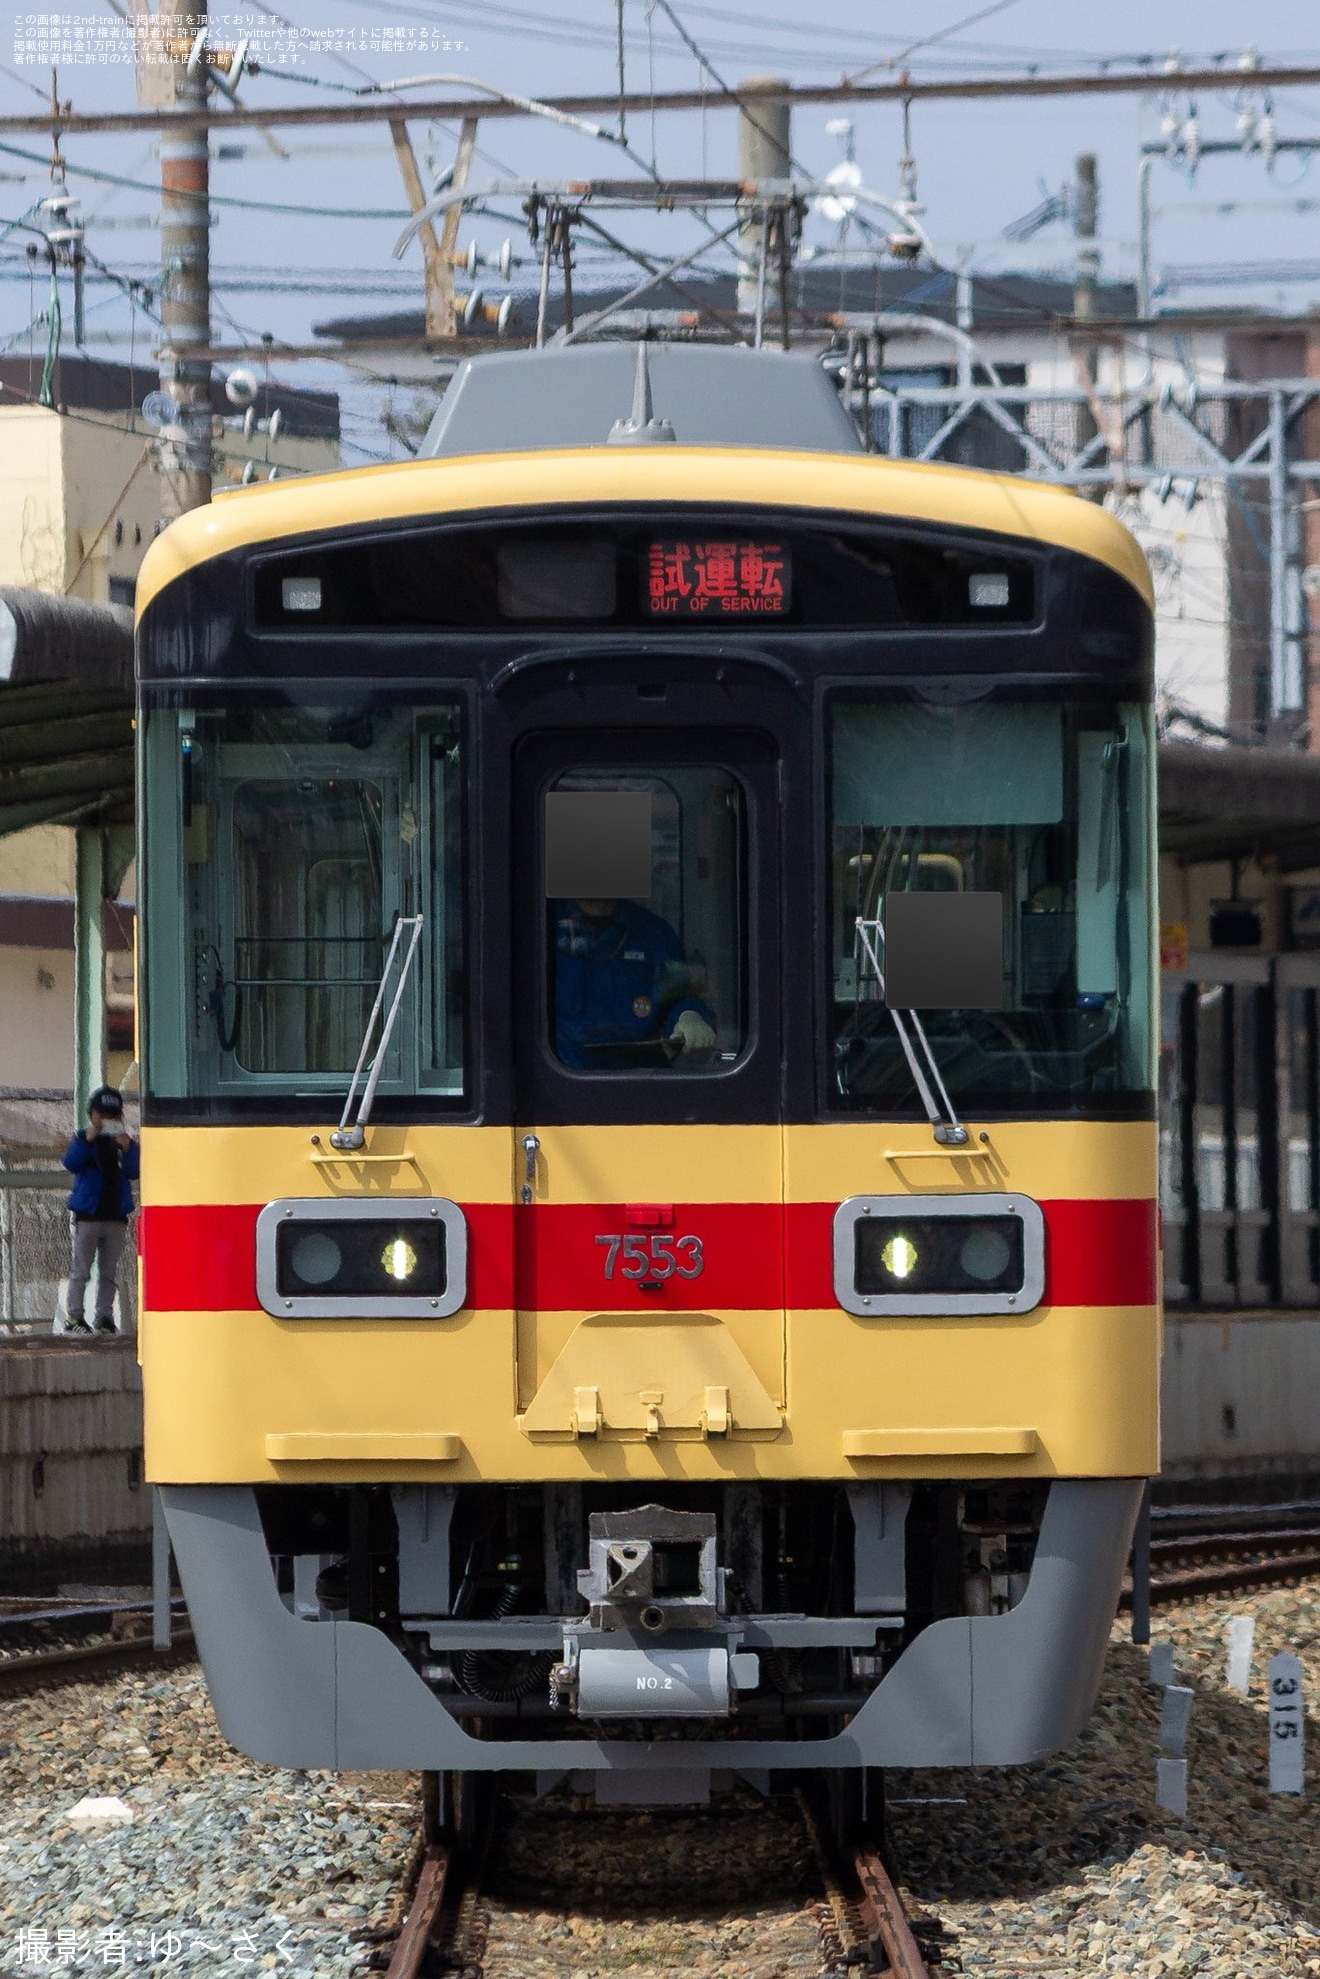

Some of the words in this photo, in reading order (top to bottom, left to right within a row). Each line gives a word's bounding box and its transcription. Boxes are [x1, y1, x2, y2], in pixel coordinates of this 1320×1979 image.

[649, 543, 783, 596] 試運転
[650, 598, 678, 611] OUT
[690, 598, 709, 611] OF
[721, 598, 782, 611] SERVICE
[595, 1234, 704, 1279] 7553
[637, 1677, 672, 1690] NO.2
[1272, 1678, 1298, 1739] 315
